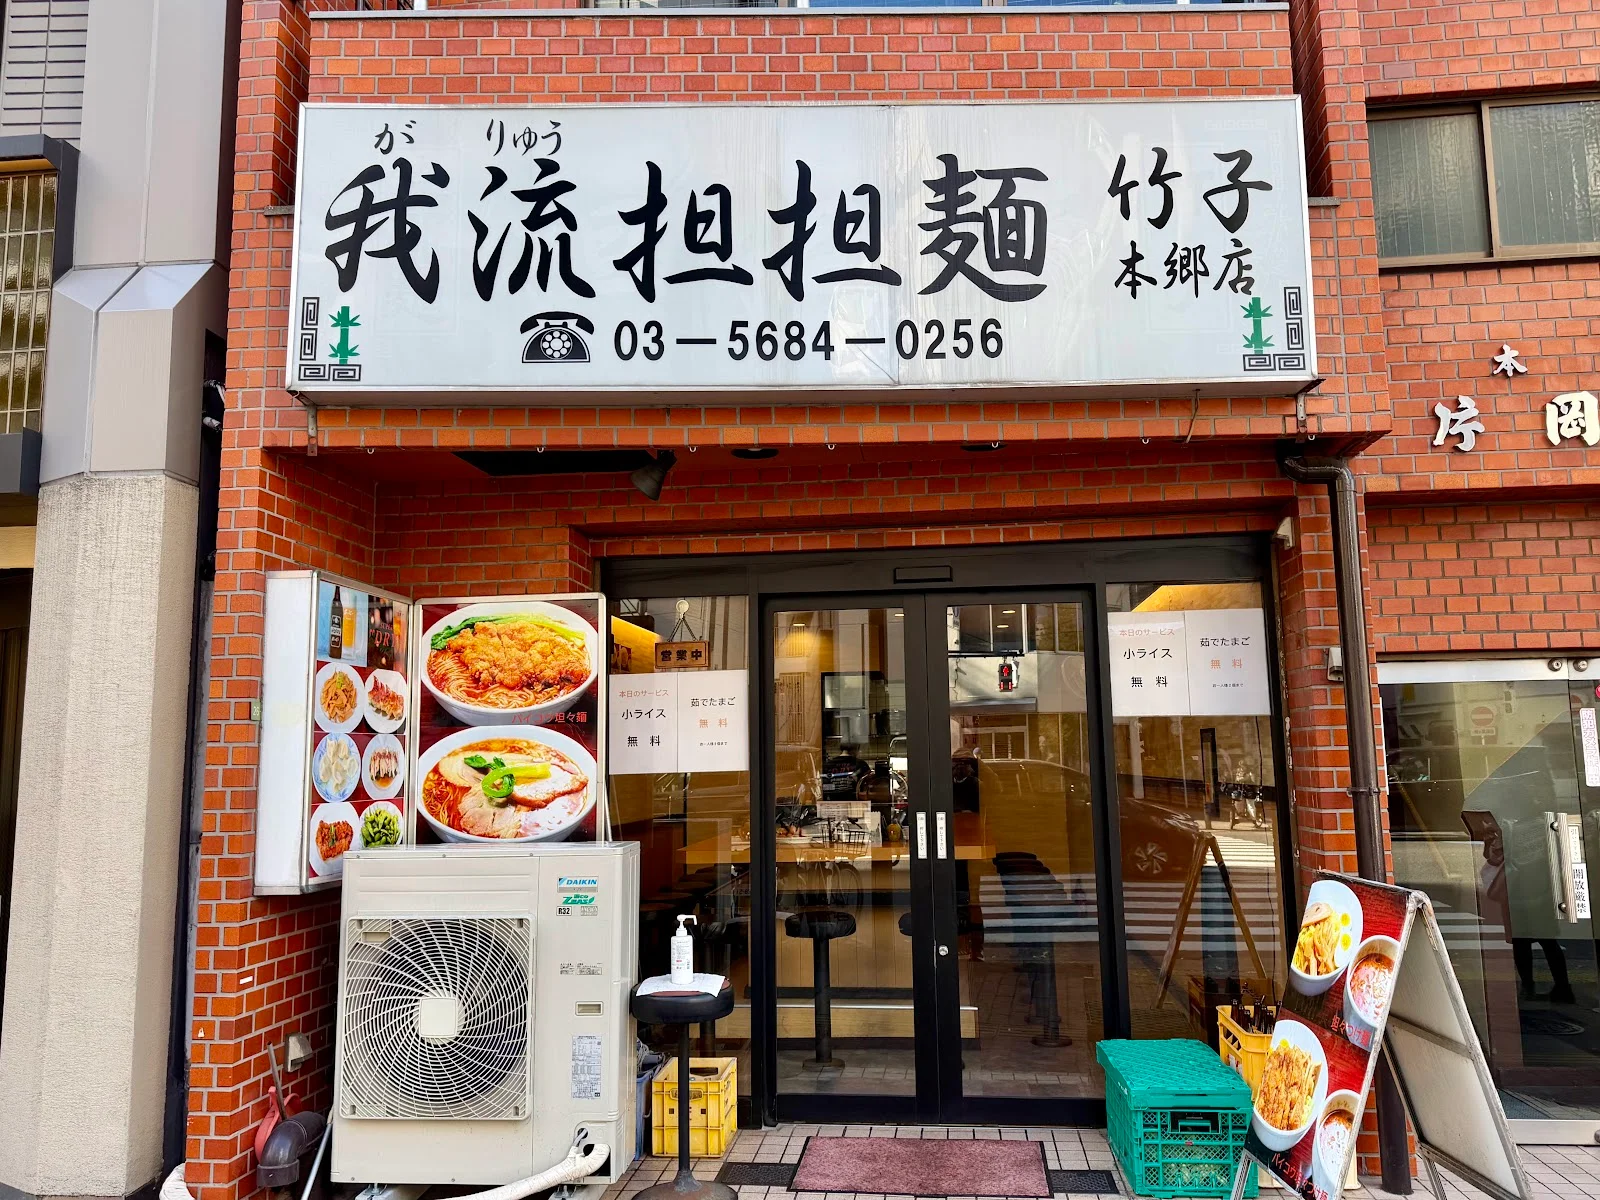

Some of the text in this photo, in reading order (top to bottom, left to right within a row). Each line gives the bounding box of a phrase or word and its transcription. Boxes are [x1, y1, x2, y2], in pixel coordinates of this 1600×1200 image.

[374, 120, 416, 155] が
[487, 118, 562, 156] りゅう
[1108, 147, 1272, 233] 竹子
[1114, 238, 1254, 299] 本郷店
[1119, 628, 1175, 637] 本日のサービス
[1200, 636, 1251, 648] 茹でたまご
[661, 649, 702, 661] 営業中
[1123, 648, 1173, 660] 小ライス
[618, 689, 669, 698] 本日のサービス
[690, 696, 736, 707] 茹でたまご
[621, 708, 667, 720] 小ライス
